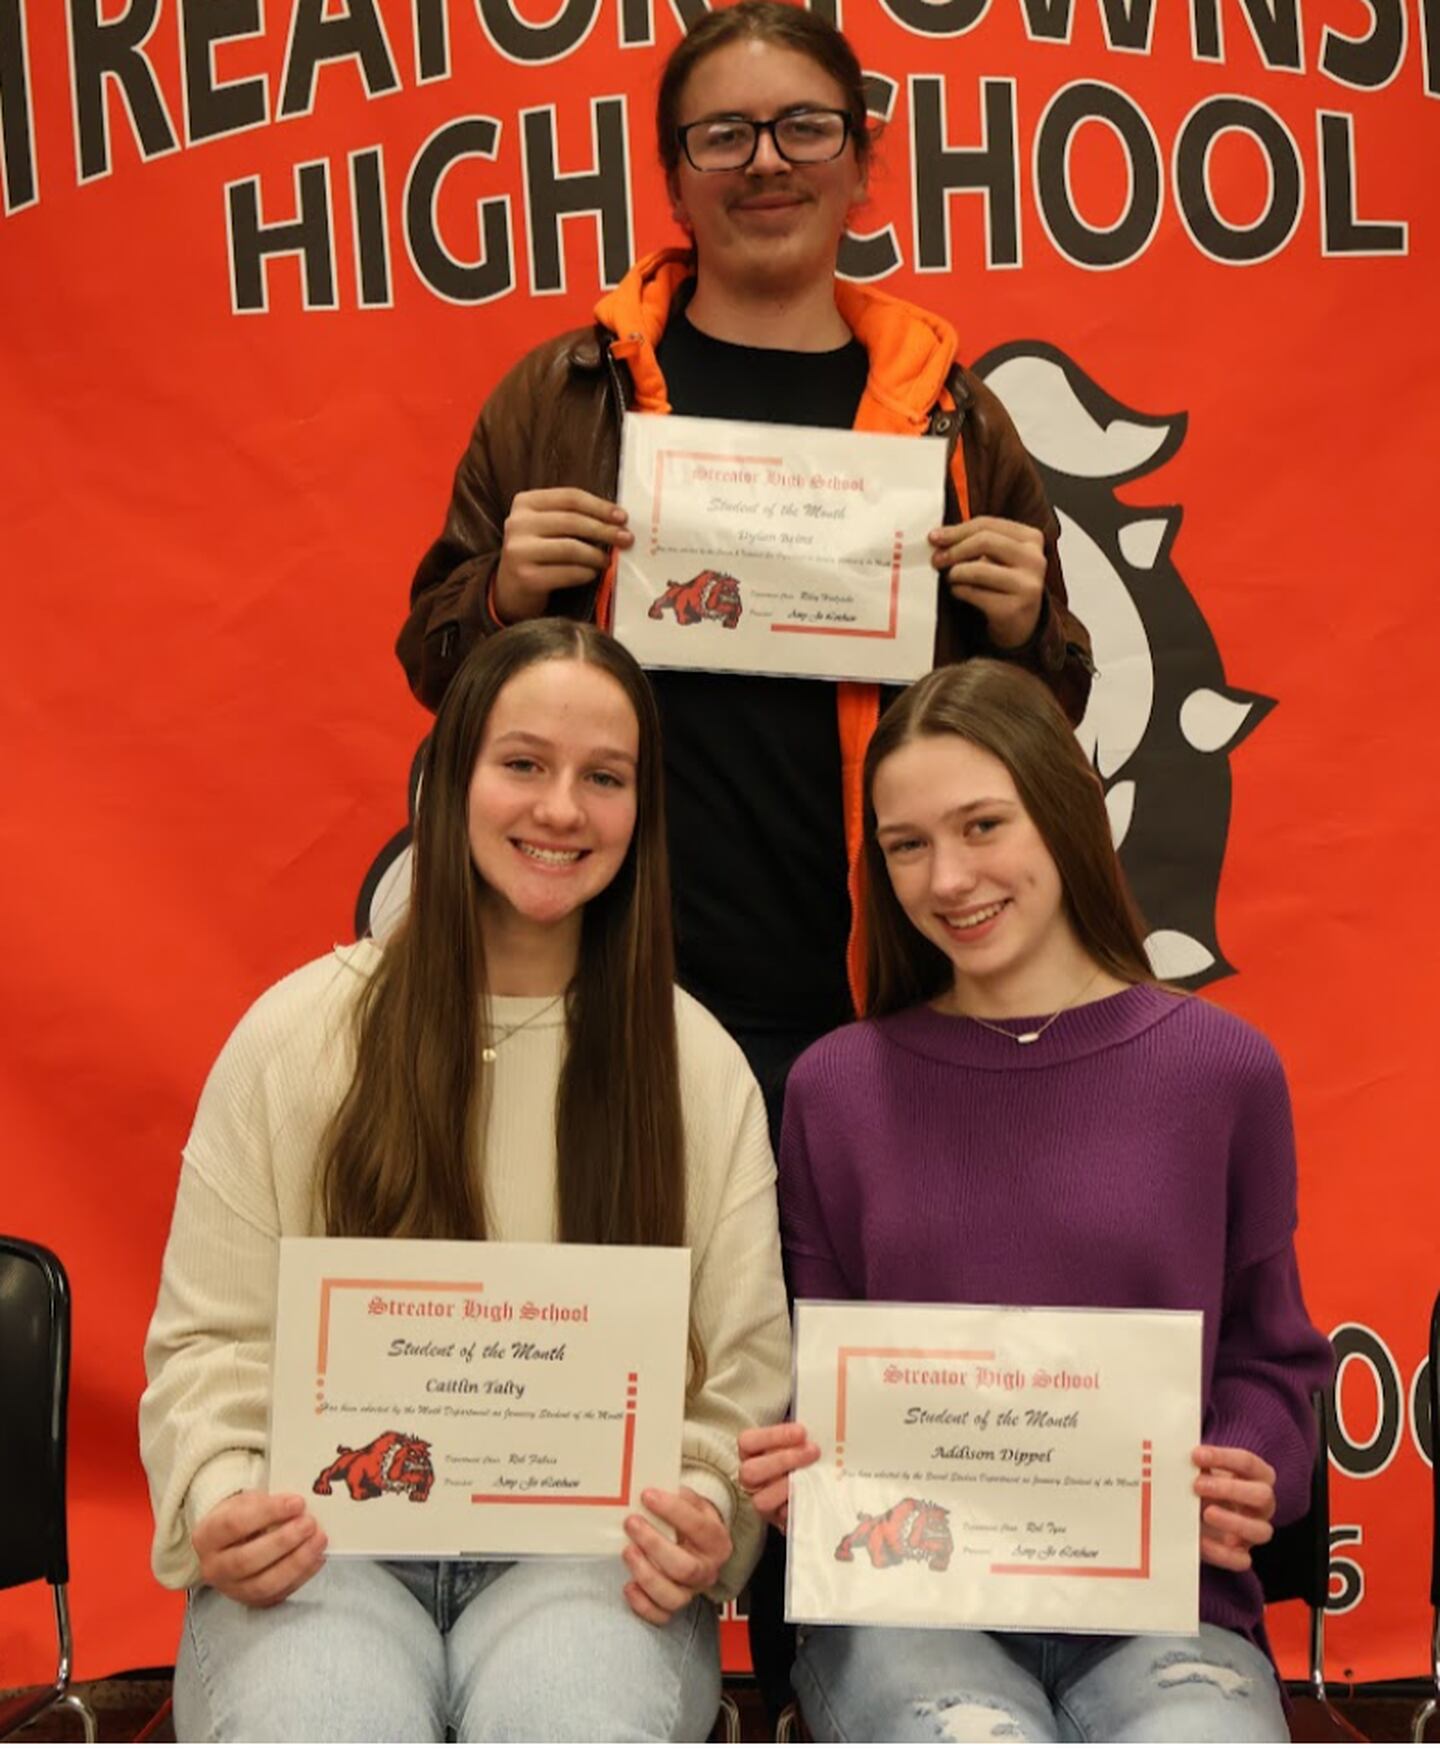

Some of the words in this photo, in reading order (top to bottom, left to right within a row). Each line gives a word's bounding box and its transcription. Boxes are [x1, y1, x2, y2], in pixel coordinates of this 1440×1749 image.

[224, 95, 636, 315] HIGH
[834, 70, 1409, 284] HOOL
[707, 497, 759, 514] Student
[763, 502, 776, 519] of
[780, 502, 799, 517] the
[802, 503, 847, 520] Month
[367, 1296, 455, 1318] Streator
[462, 1298, 514, 1323] High
[519, 1301, 589, 1325] School
[387, 1338, 455, 1359] Student
[459, 1341, 476, 1363] of
[482, 1341, 505, 1360] the
[511, 1341, 567, 1362] Month
[425, 1377, 478, 1394] Caitlin
[484, 1379, 526, 1400] Talty
[883, 1364, 967, 1387] Streator
[975, 1366, 1026, 1391] High
[1031, 1369, 1100, 1392] School
[903, 1406, 970, 1427] Student
[973, 1409, 991, 1431] of
[996, 1408, 1019, 1428] the
[1024, 1408, 1079, 1429] Month
[930, 1445, 996, 1462] Addison
[999, 1447, 1055, 1466] Dippel
